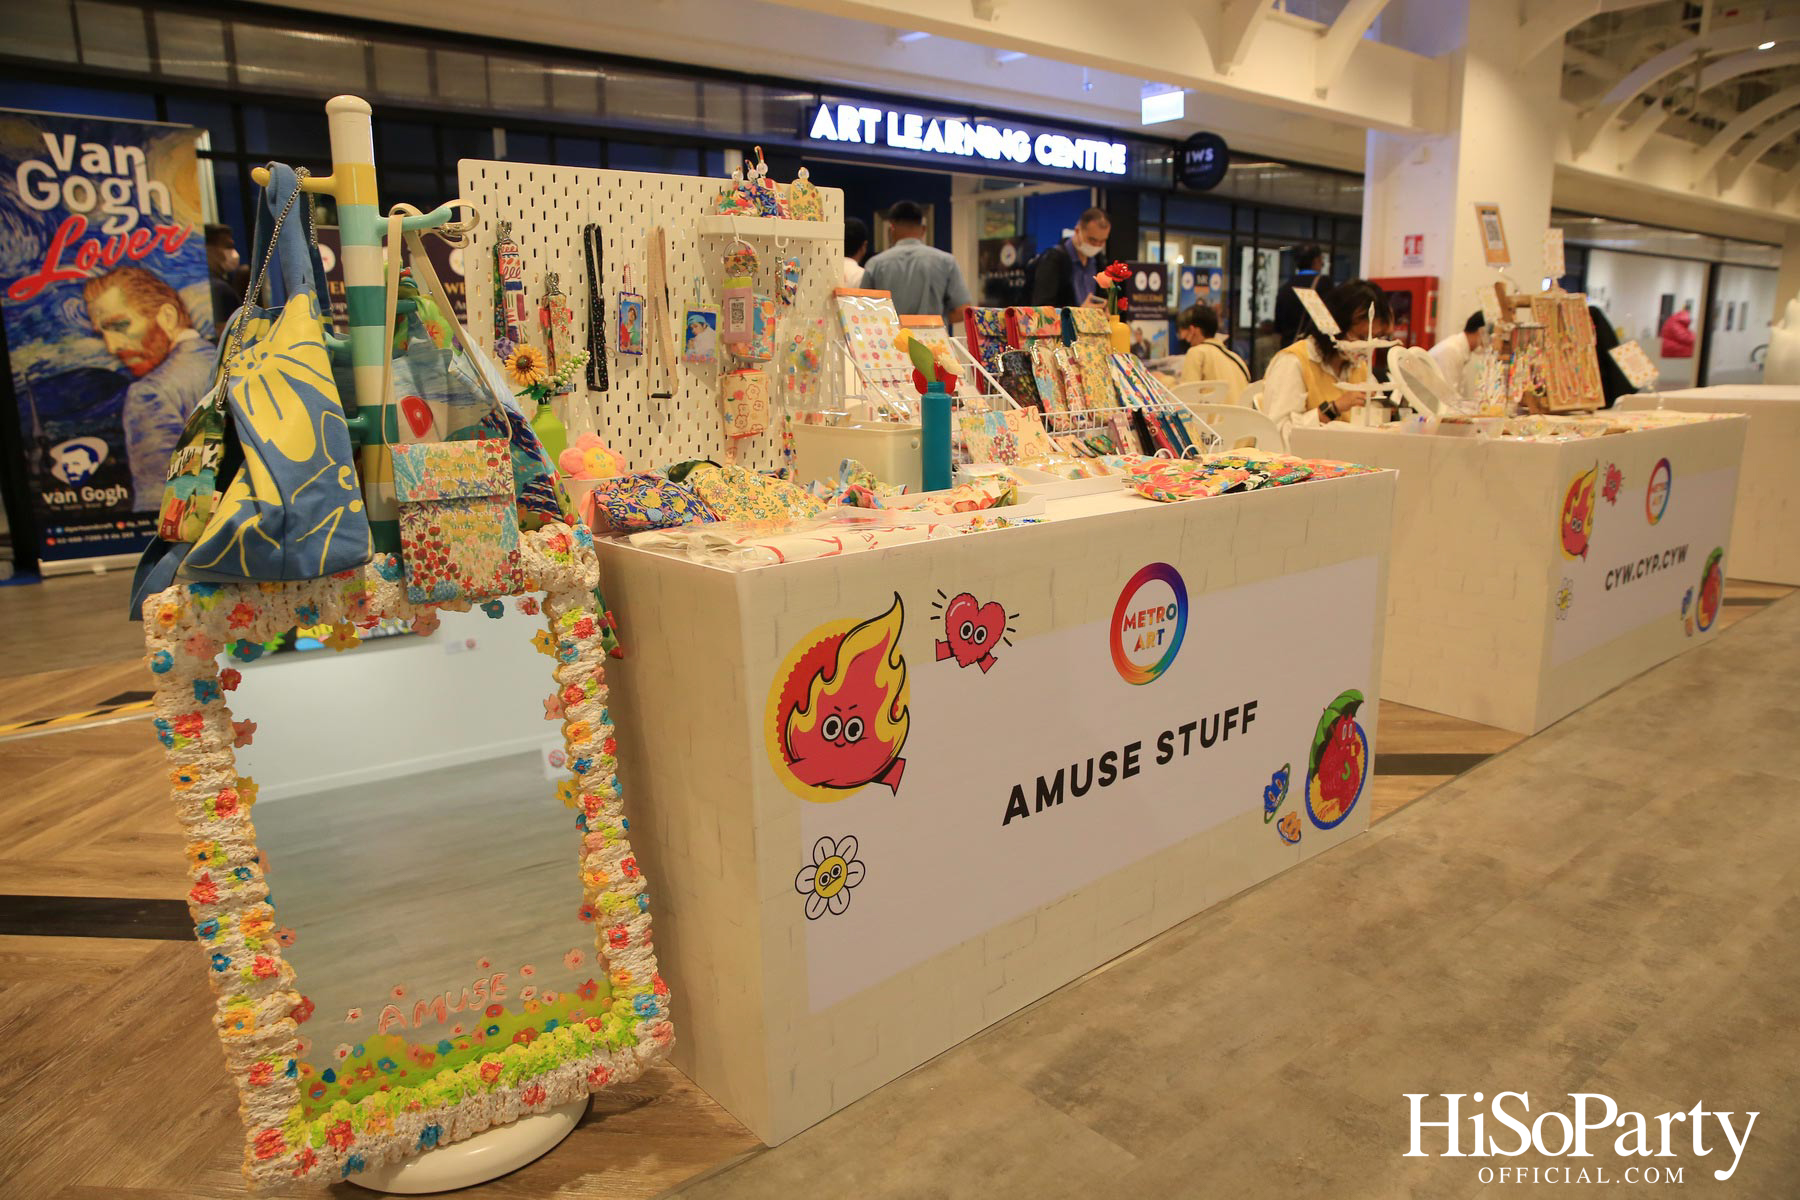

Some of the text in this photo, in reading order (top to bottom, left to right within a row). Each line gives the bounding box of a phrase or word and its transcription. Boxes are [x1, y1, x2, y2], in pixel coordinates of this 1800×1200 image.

[43, 132, 147, 179] Van
[810, 104, 1127, 175] ART LEARNING CENTRE
[16, 159, 172, 235] Gogh
[8, 214, 194, 301] Lover
[42, 484, 128, 506] van Gogh
[1123, 603, 1177, 632] METRO
[1134, 628, 1165, 652] ART
[1002, 700, 1258, 826] AMUSE STUFF
[378, 972, 508, 1035] AMUSE
